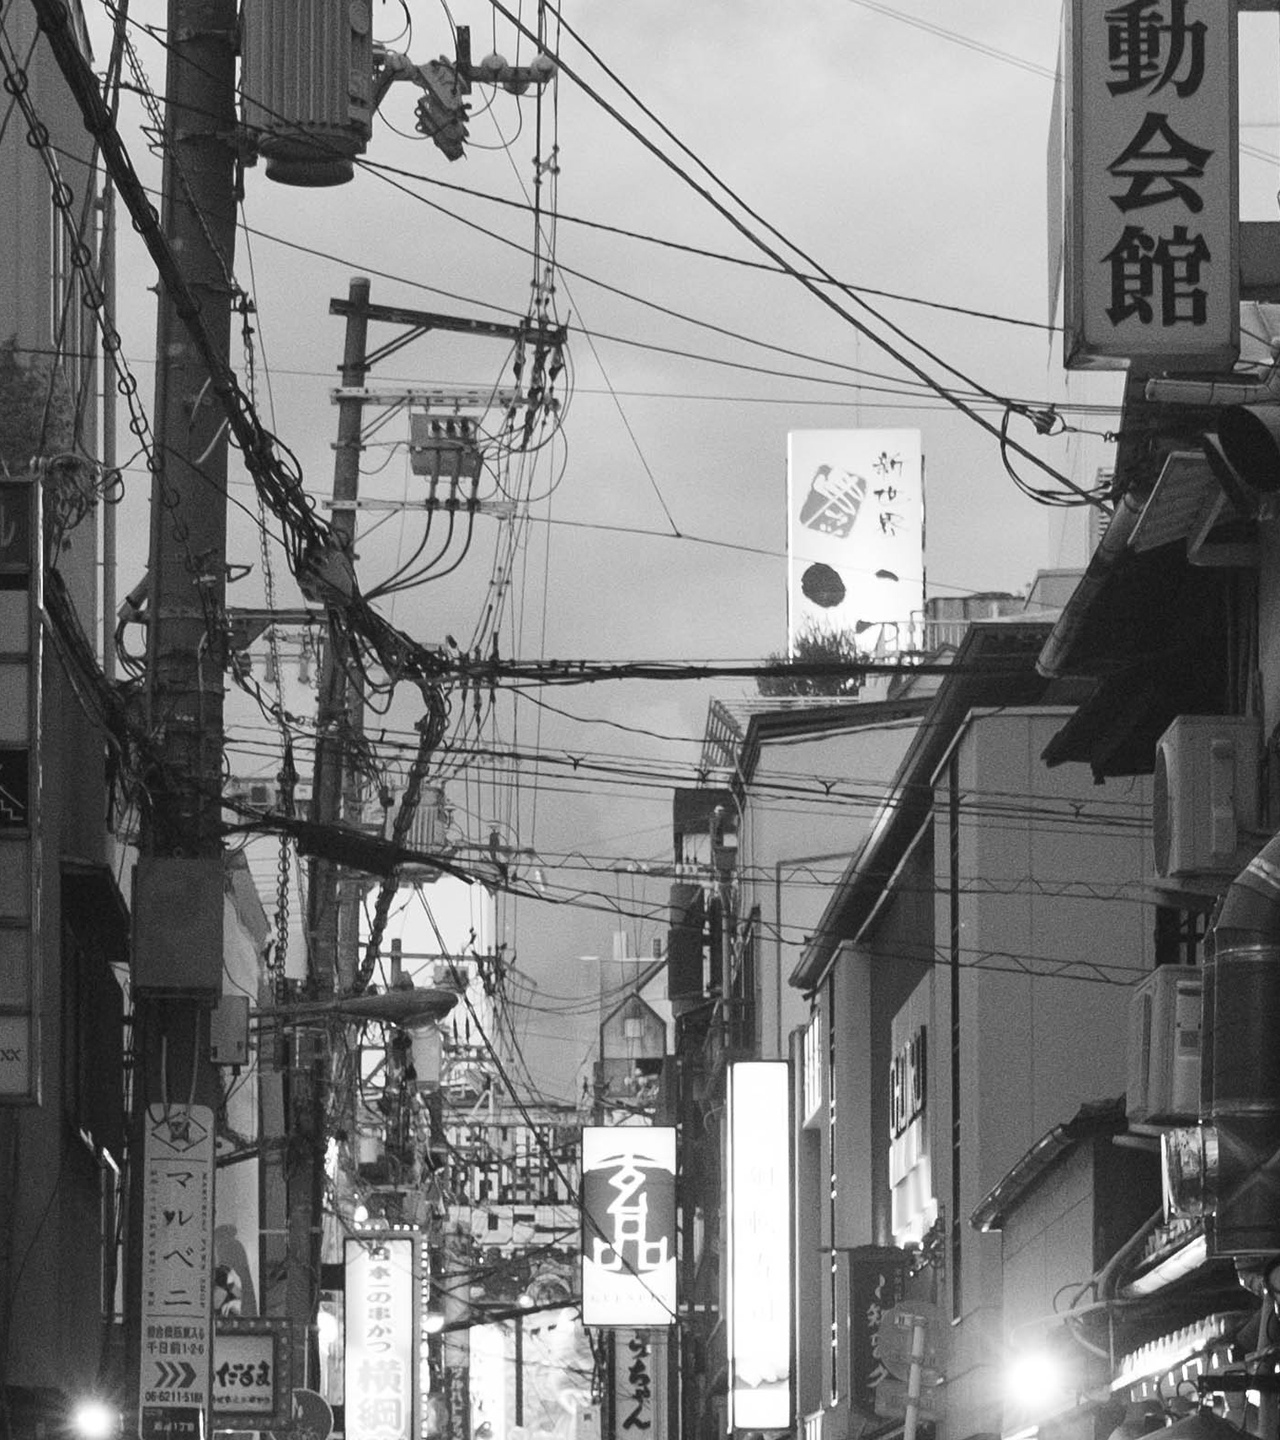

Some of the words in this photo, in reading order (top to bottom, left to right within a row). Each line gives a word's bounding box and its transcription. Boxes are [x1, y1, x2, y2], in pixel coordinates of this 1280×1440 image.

[163, 1170, 194, 1306] マルベニ
[357, 1358, 402, 1432] 横綱
